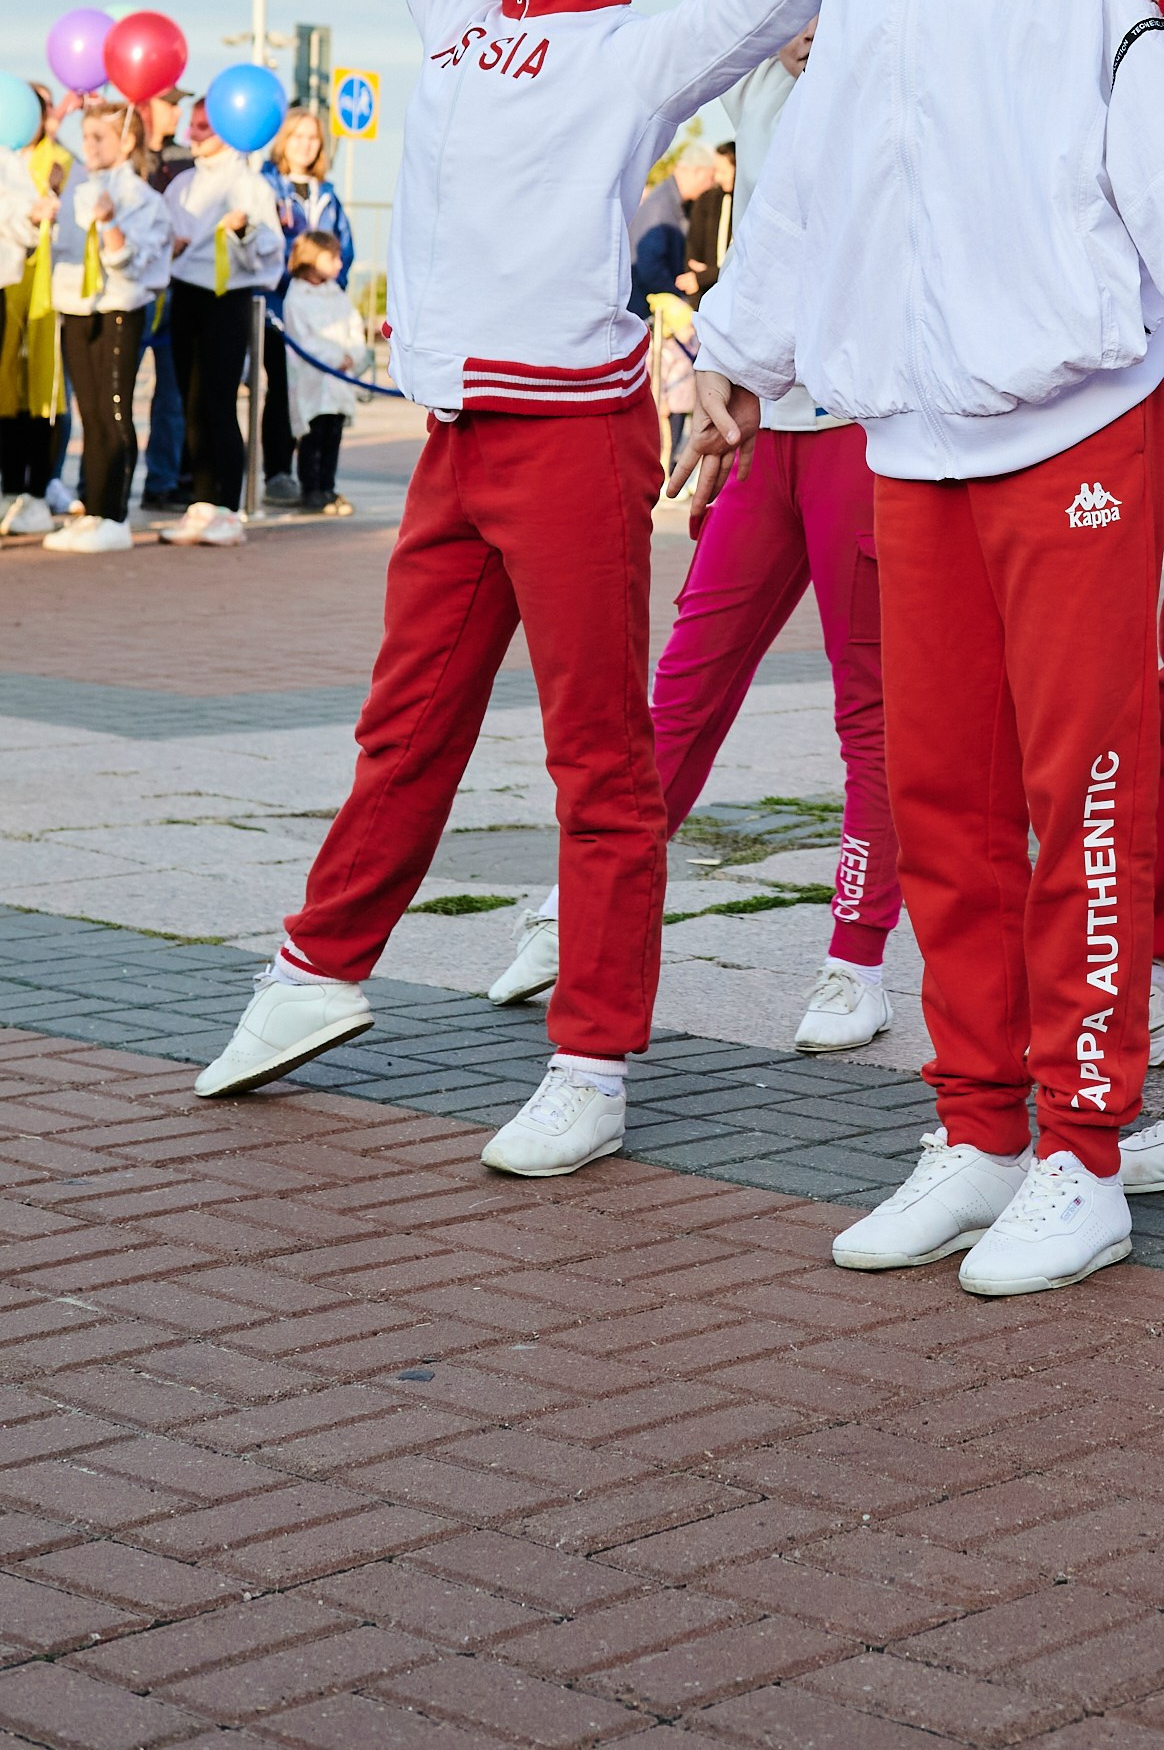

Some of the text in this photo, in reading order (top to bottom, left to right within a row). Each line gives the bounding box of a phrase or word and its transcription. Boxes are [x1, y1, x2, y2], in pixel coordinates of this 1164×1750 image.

[1068, 506, 1121, 529] Kappa
[1070, 750, 1120, 1112] APPA AUTHENTIC
